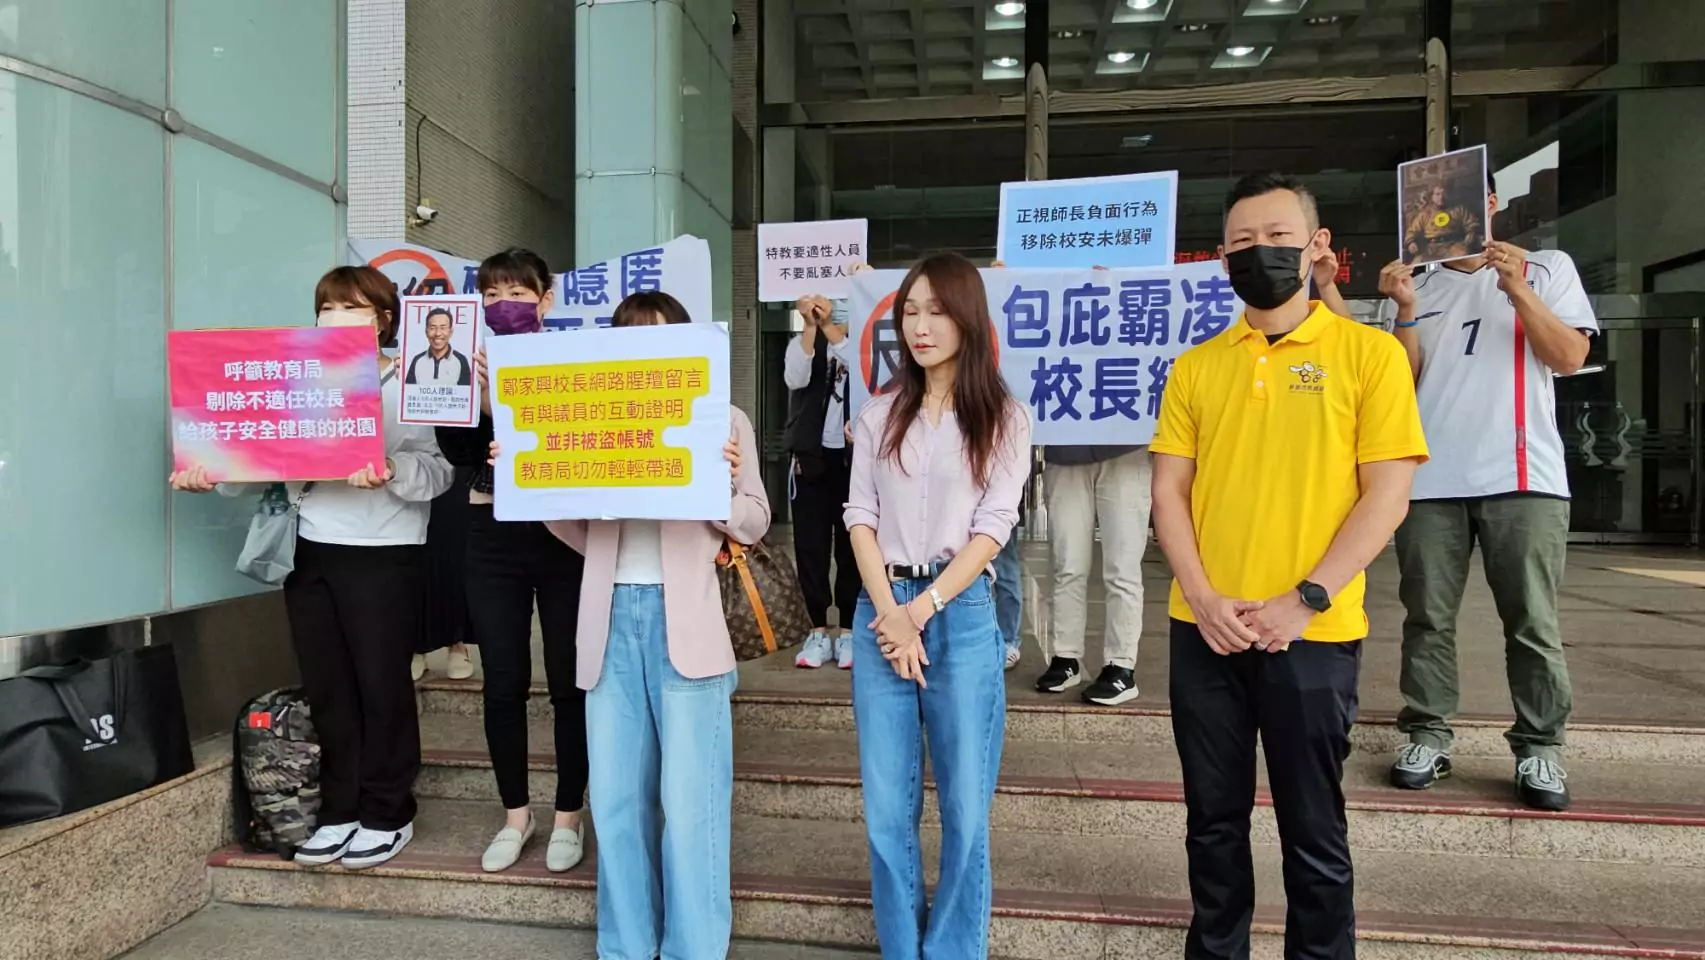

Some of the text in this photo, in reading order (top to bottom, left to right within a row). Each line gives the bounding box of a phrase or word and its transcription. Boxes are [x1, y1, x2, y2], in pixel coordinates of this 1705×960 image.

[1016, 201, 1158, 223] 正視師長負面行為
[1021, 228, 1152, 250] 移除校安未爆彈
[766, 244, 860, 260] 特教要適性人員
[780, 265, 846, 280] 不要亂塞人
[1002, 275, 1235, 349] 包庇霸凌
[224, 359, 323, 381] 呼籲教育局
[503, 368, 703, 397] 鄭家興校長網路腥羶留言
[206, 388, 344, 411] 剔除不適任校長
[520, 399, 683, 424] 有與議員的互動證明
[178, 417, 376, 441] 給孩子安全健康的校園
[546, 429, 655, 451] 並非被盜帳號
[521, 459, 684, 481] 教育局切勿輕輕帶過
